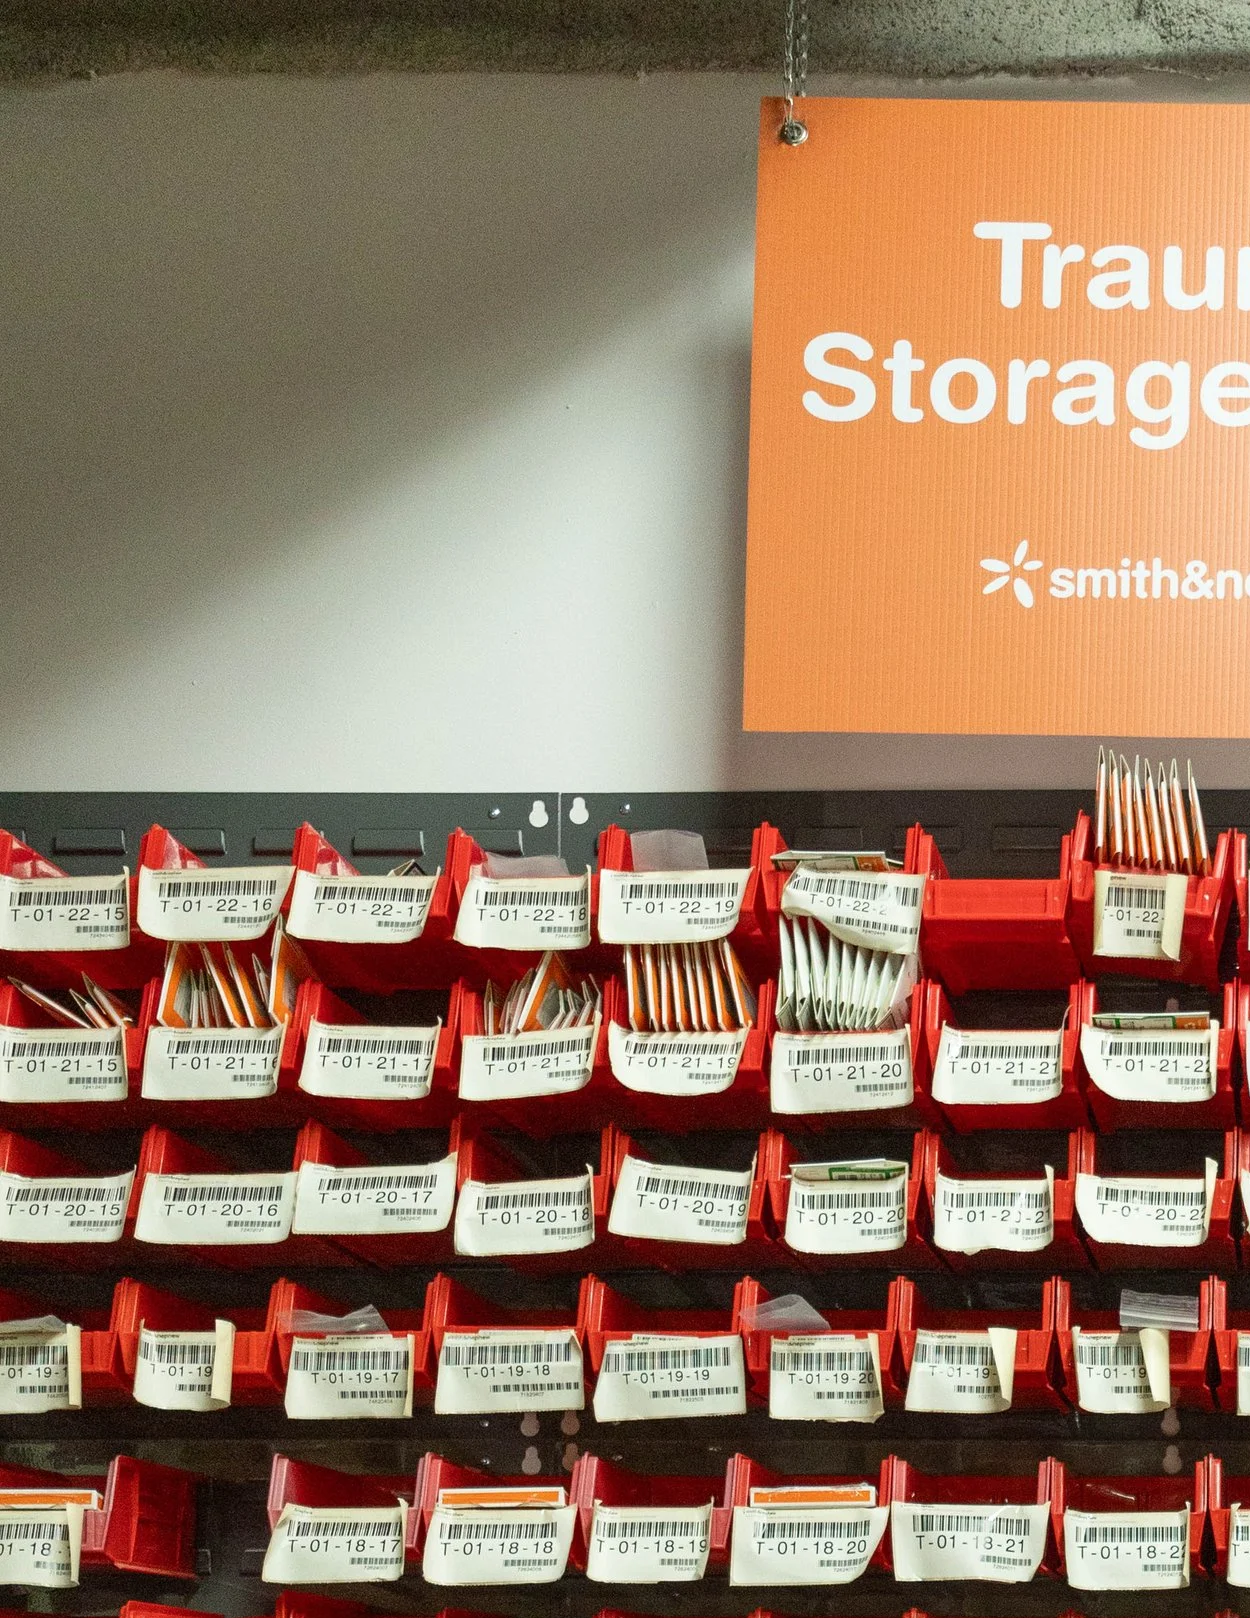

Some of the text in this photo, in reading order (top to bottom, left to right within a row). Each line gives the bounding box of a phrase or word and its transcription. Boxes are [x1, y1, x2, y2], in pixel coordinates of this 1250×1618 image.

[159, 898, 272, 913] T-01-22-16
[622, 900, 735, 914] T-01-22-19
[10, 908, 125, 922] T-01-22-15
[476, 908, 586, 922] T-01-22-18
[4, 1058, 118, 1074] T-01-21-15
[626, 1055, 738, 1069] T-01-21-19
[948, 1061, 1058, 1075] T-01-21-21
[791, 1064, 902, 1083] T-01-21-20
[319, 1191, 432, 1204] T-01-20-17
[7, 1203, 121, 1217] T-01-20-15
[164, 1203, 278, 1217] T-01-20-16
[636, 1195, 746, 1217] T-01-20-19
[478, 1208, 590, 1225] T-01-20-18
[311, 1372, 399, 1384] T-01-19-17
[463, 1365, 551, 1379] T-01-19-18
[622, 1369, 710, 1384] T-01-19-19
[788, 1372, 875, 1386] T-01-19-20
[288, 1539, 400, 1554] T-01-18-17
[440, 1541, 553, 1556] T-01-18-18
[597, 1539, 708, 1554] T-01-18-19
[756, 1540, 867, 1555] T-01-18-20
